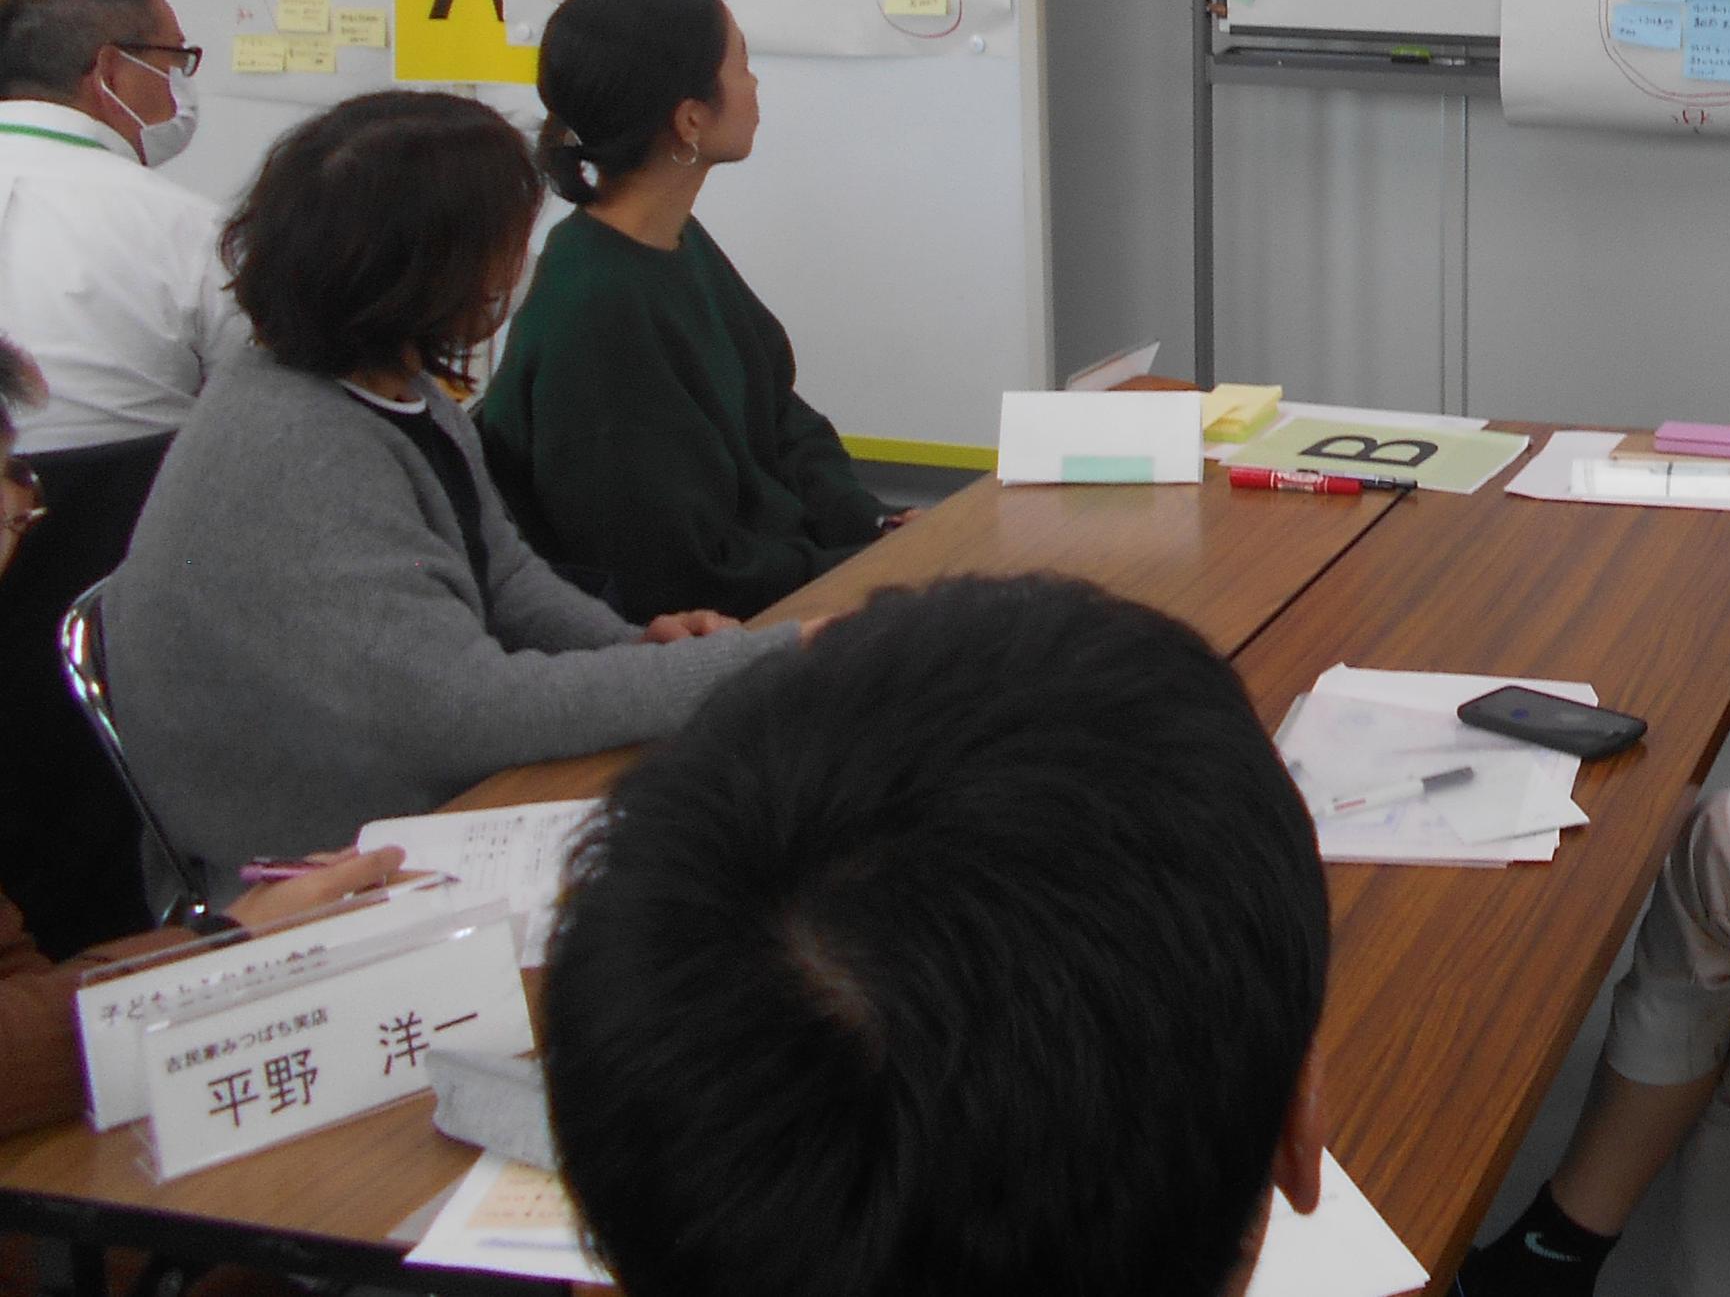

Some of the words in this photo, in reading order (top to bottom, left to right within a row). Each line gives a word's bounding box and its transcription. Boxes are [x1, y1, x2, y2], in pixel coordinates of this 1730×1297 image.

[1299, 435, 1439, 467] B
[207, 1048, 320, 1127] 平野
[378, 1011, 479, 1076] 洋一
